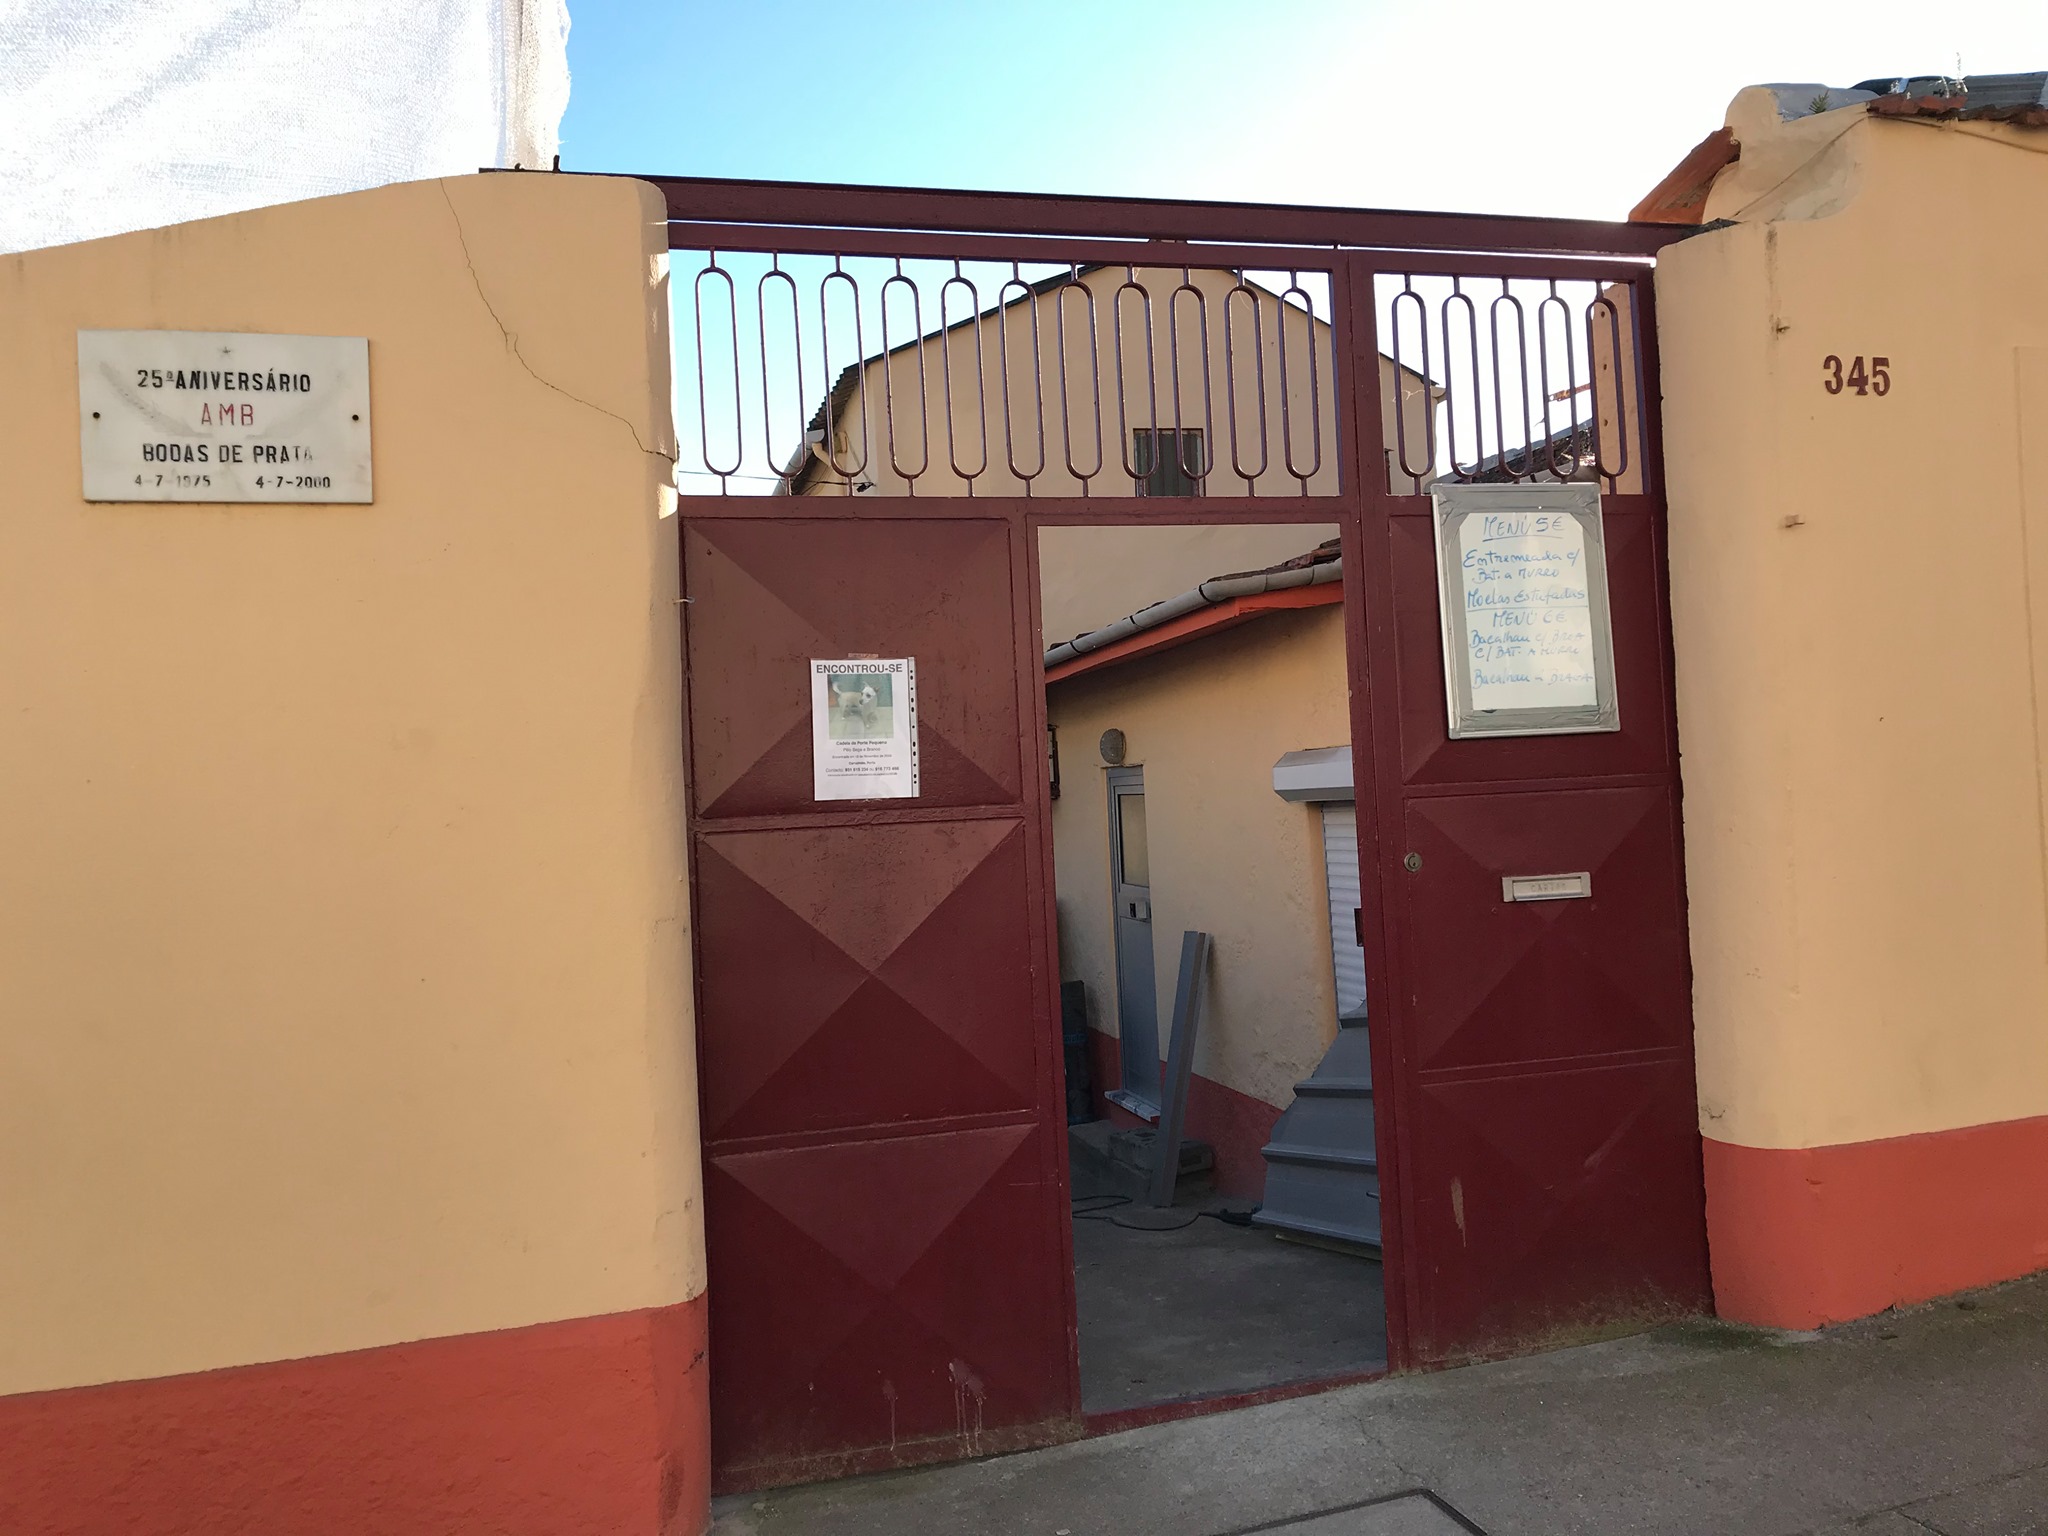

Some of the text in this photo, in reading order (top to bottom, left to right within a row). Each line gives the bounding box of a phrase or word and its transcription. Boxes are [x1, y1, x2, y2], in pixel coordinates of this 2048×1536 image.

[1823, 355, 1891, 397] 345
[200, 402, 254, 427] AMB
[142, 443, 313, 464] BODAS DE PRATA
[816, 664, 903, 674] ENCONTROU-SE
